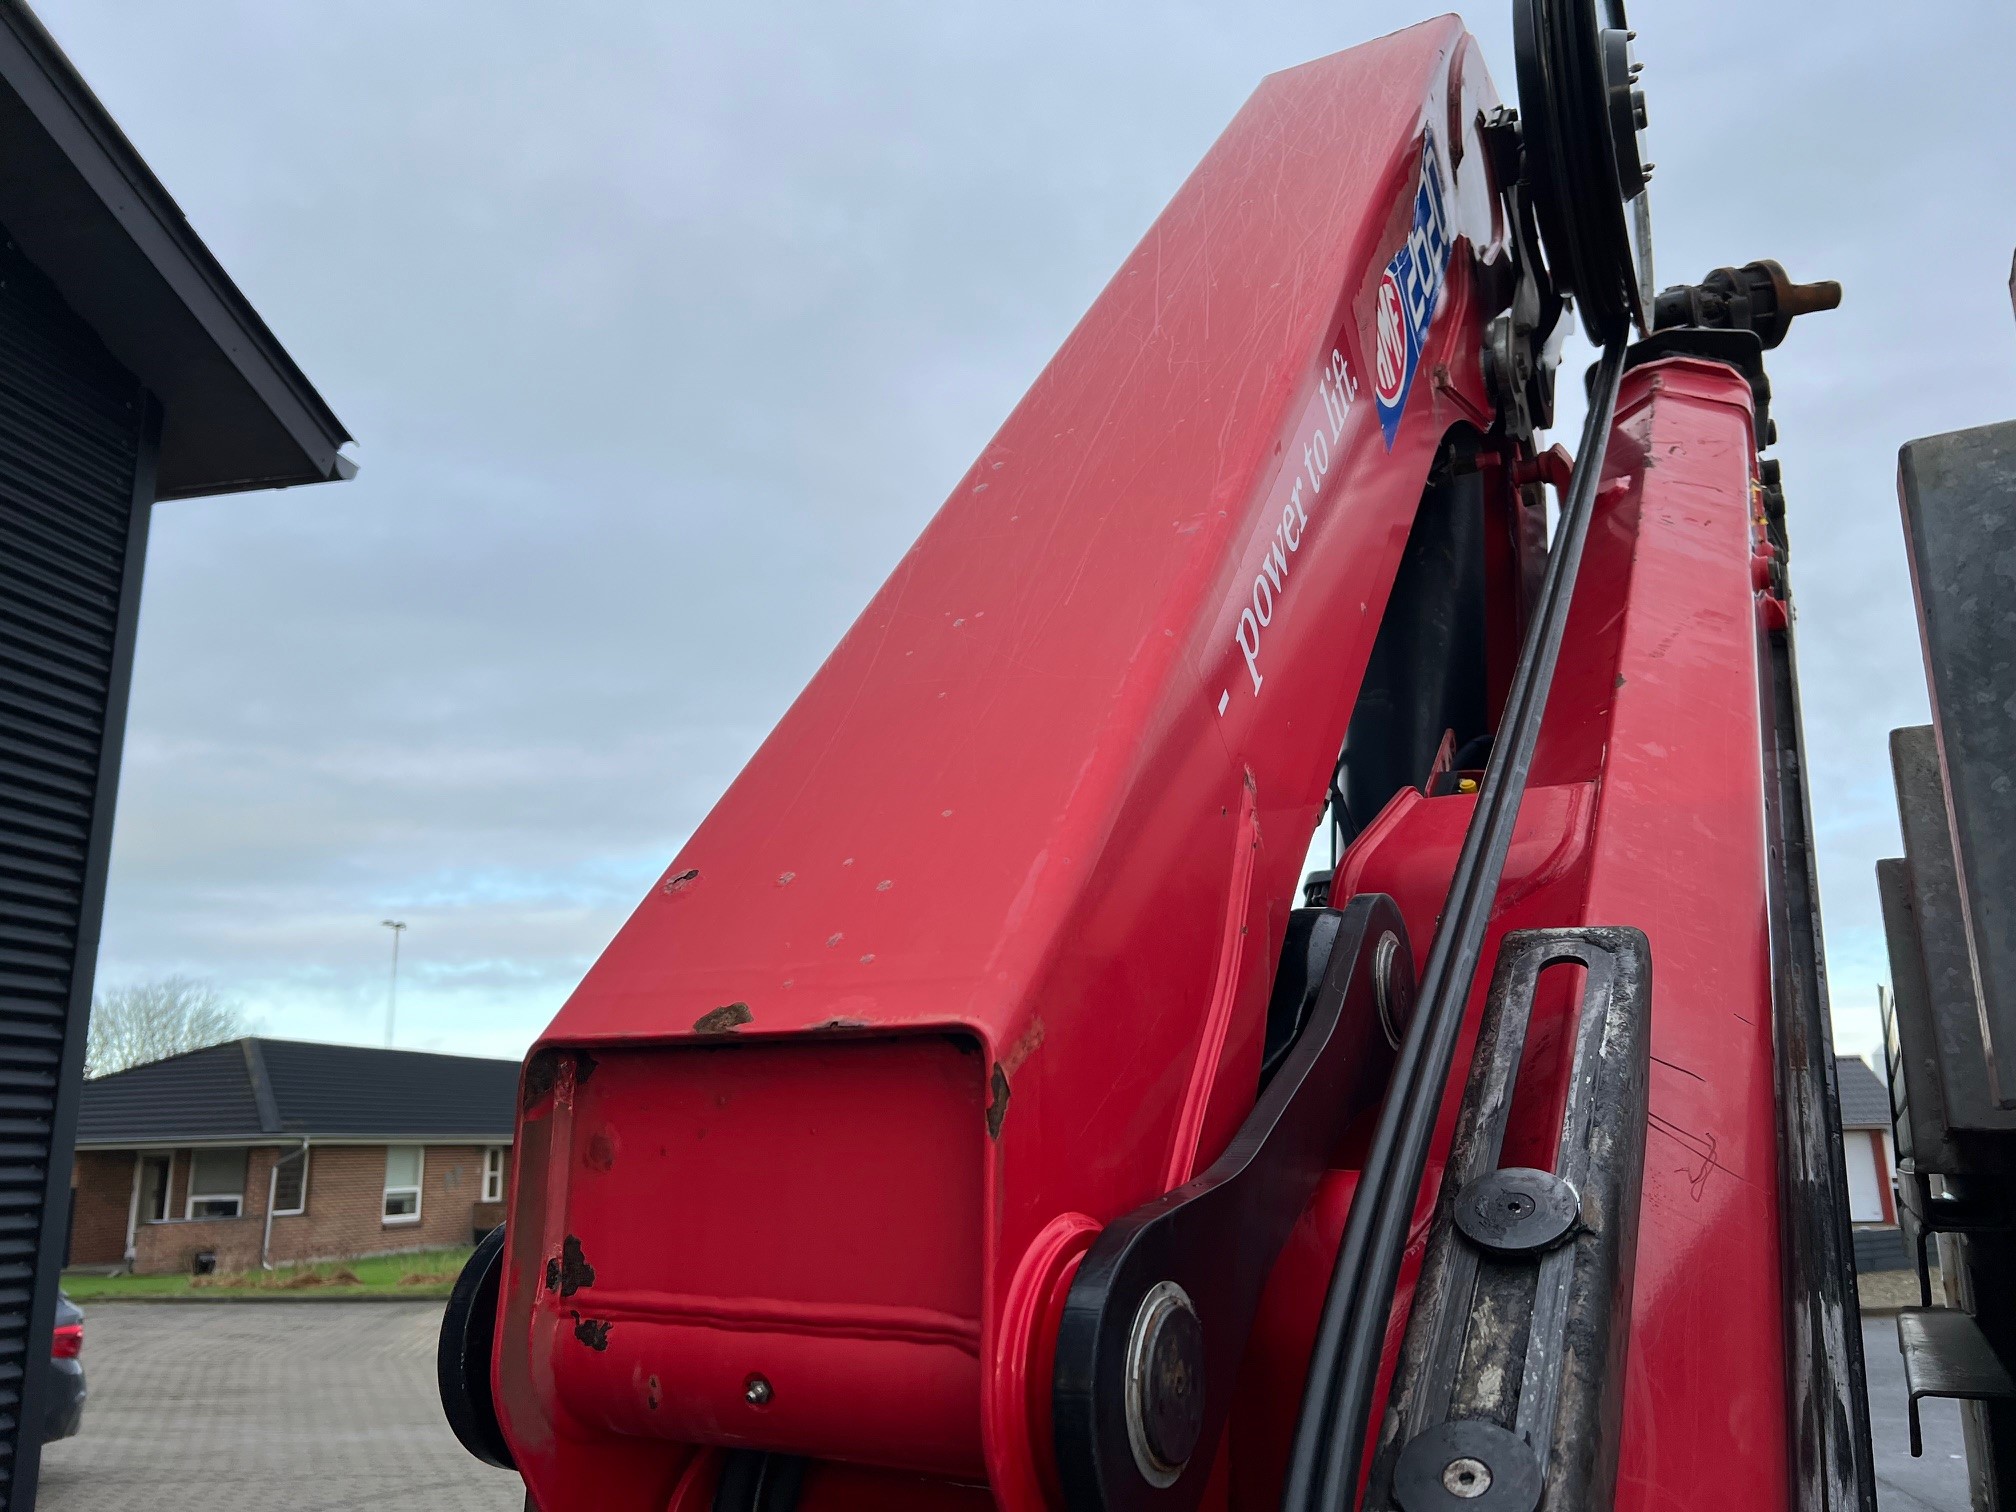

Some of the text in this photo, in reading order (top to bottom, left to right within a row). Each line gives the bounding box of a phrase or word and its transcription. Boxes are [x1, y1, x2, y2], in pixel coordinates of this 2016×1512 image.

[1235, 476, 1308, 697] power
[1303, 428, 1330, 494] to
[1319, 348, 1358, 446] lift.
